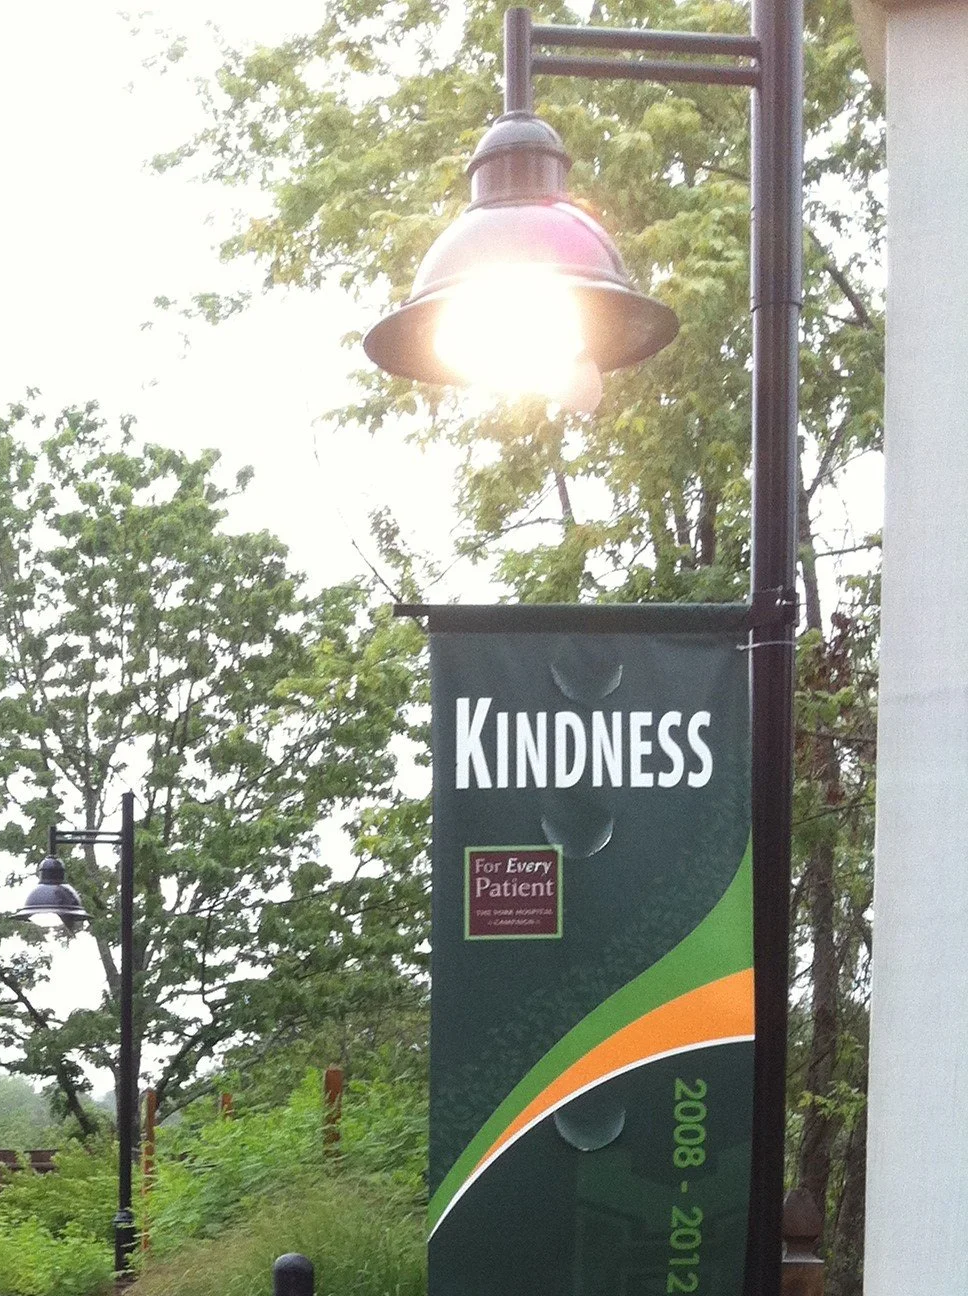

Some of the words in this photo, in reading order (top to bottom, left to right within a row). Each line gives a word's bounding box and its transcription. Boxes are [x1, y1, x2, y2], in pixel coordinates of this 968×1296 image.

[455, 697, 714, 790] KINDNESS
[474, 858, 502, 874] For
[506, 857, 552, 877] Every
[475, 877, 555, 898] Patient
[673, 1078, 707, 1168] 2008
[681, 1181, 688, 1193] -
[667, 1205, 703, 1293] 2012
